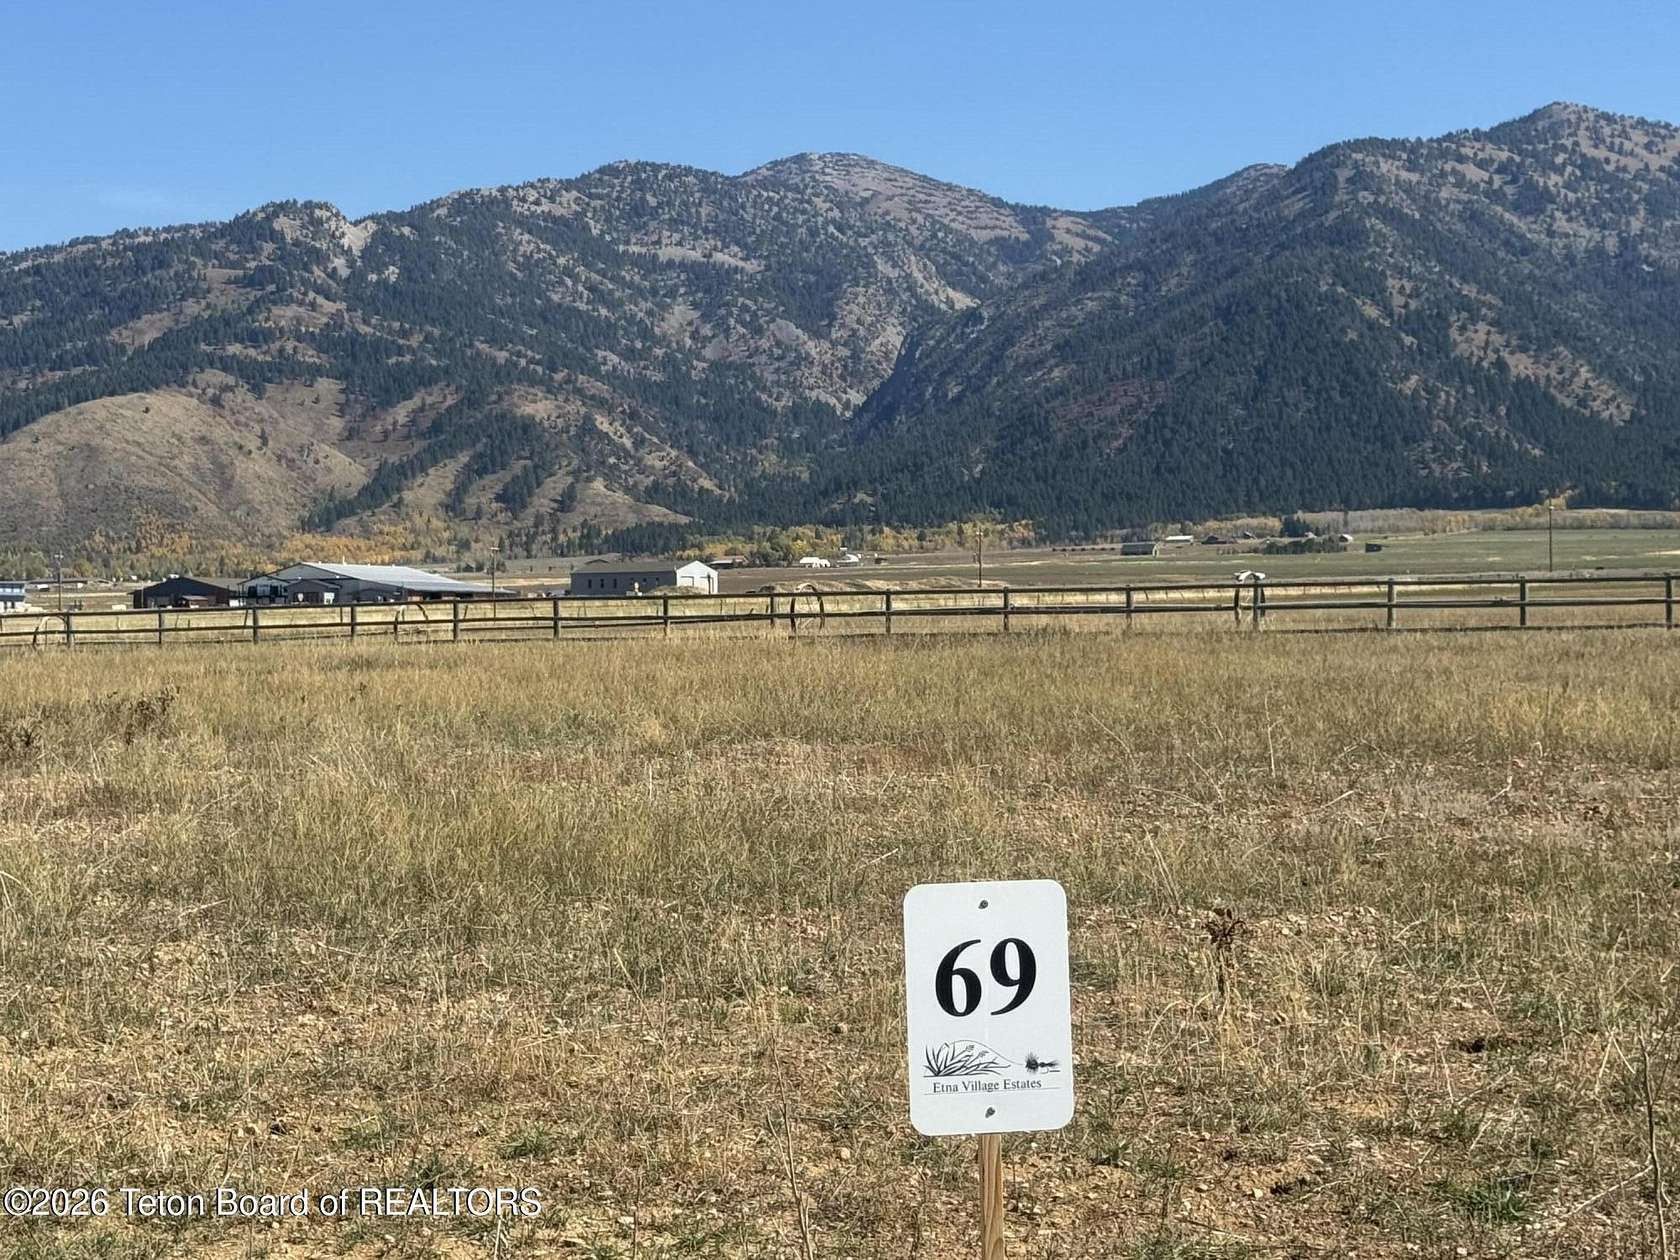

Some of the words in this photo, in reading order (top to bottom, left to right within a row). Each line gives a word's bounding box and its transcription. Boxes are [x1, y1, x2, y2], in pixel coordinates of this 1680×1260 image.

[935, 937, 1037, 1017] 69
[933, 1081, 959, 1093] Etna
[961, 1079, 1000, 1093] Village
[1003, 1078, 1042, 1090] Estates
